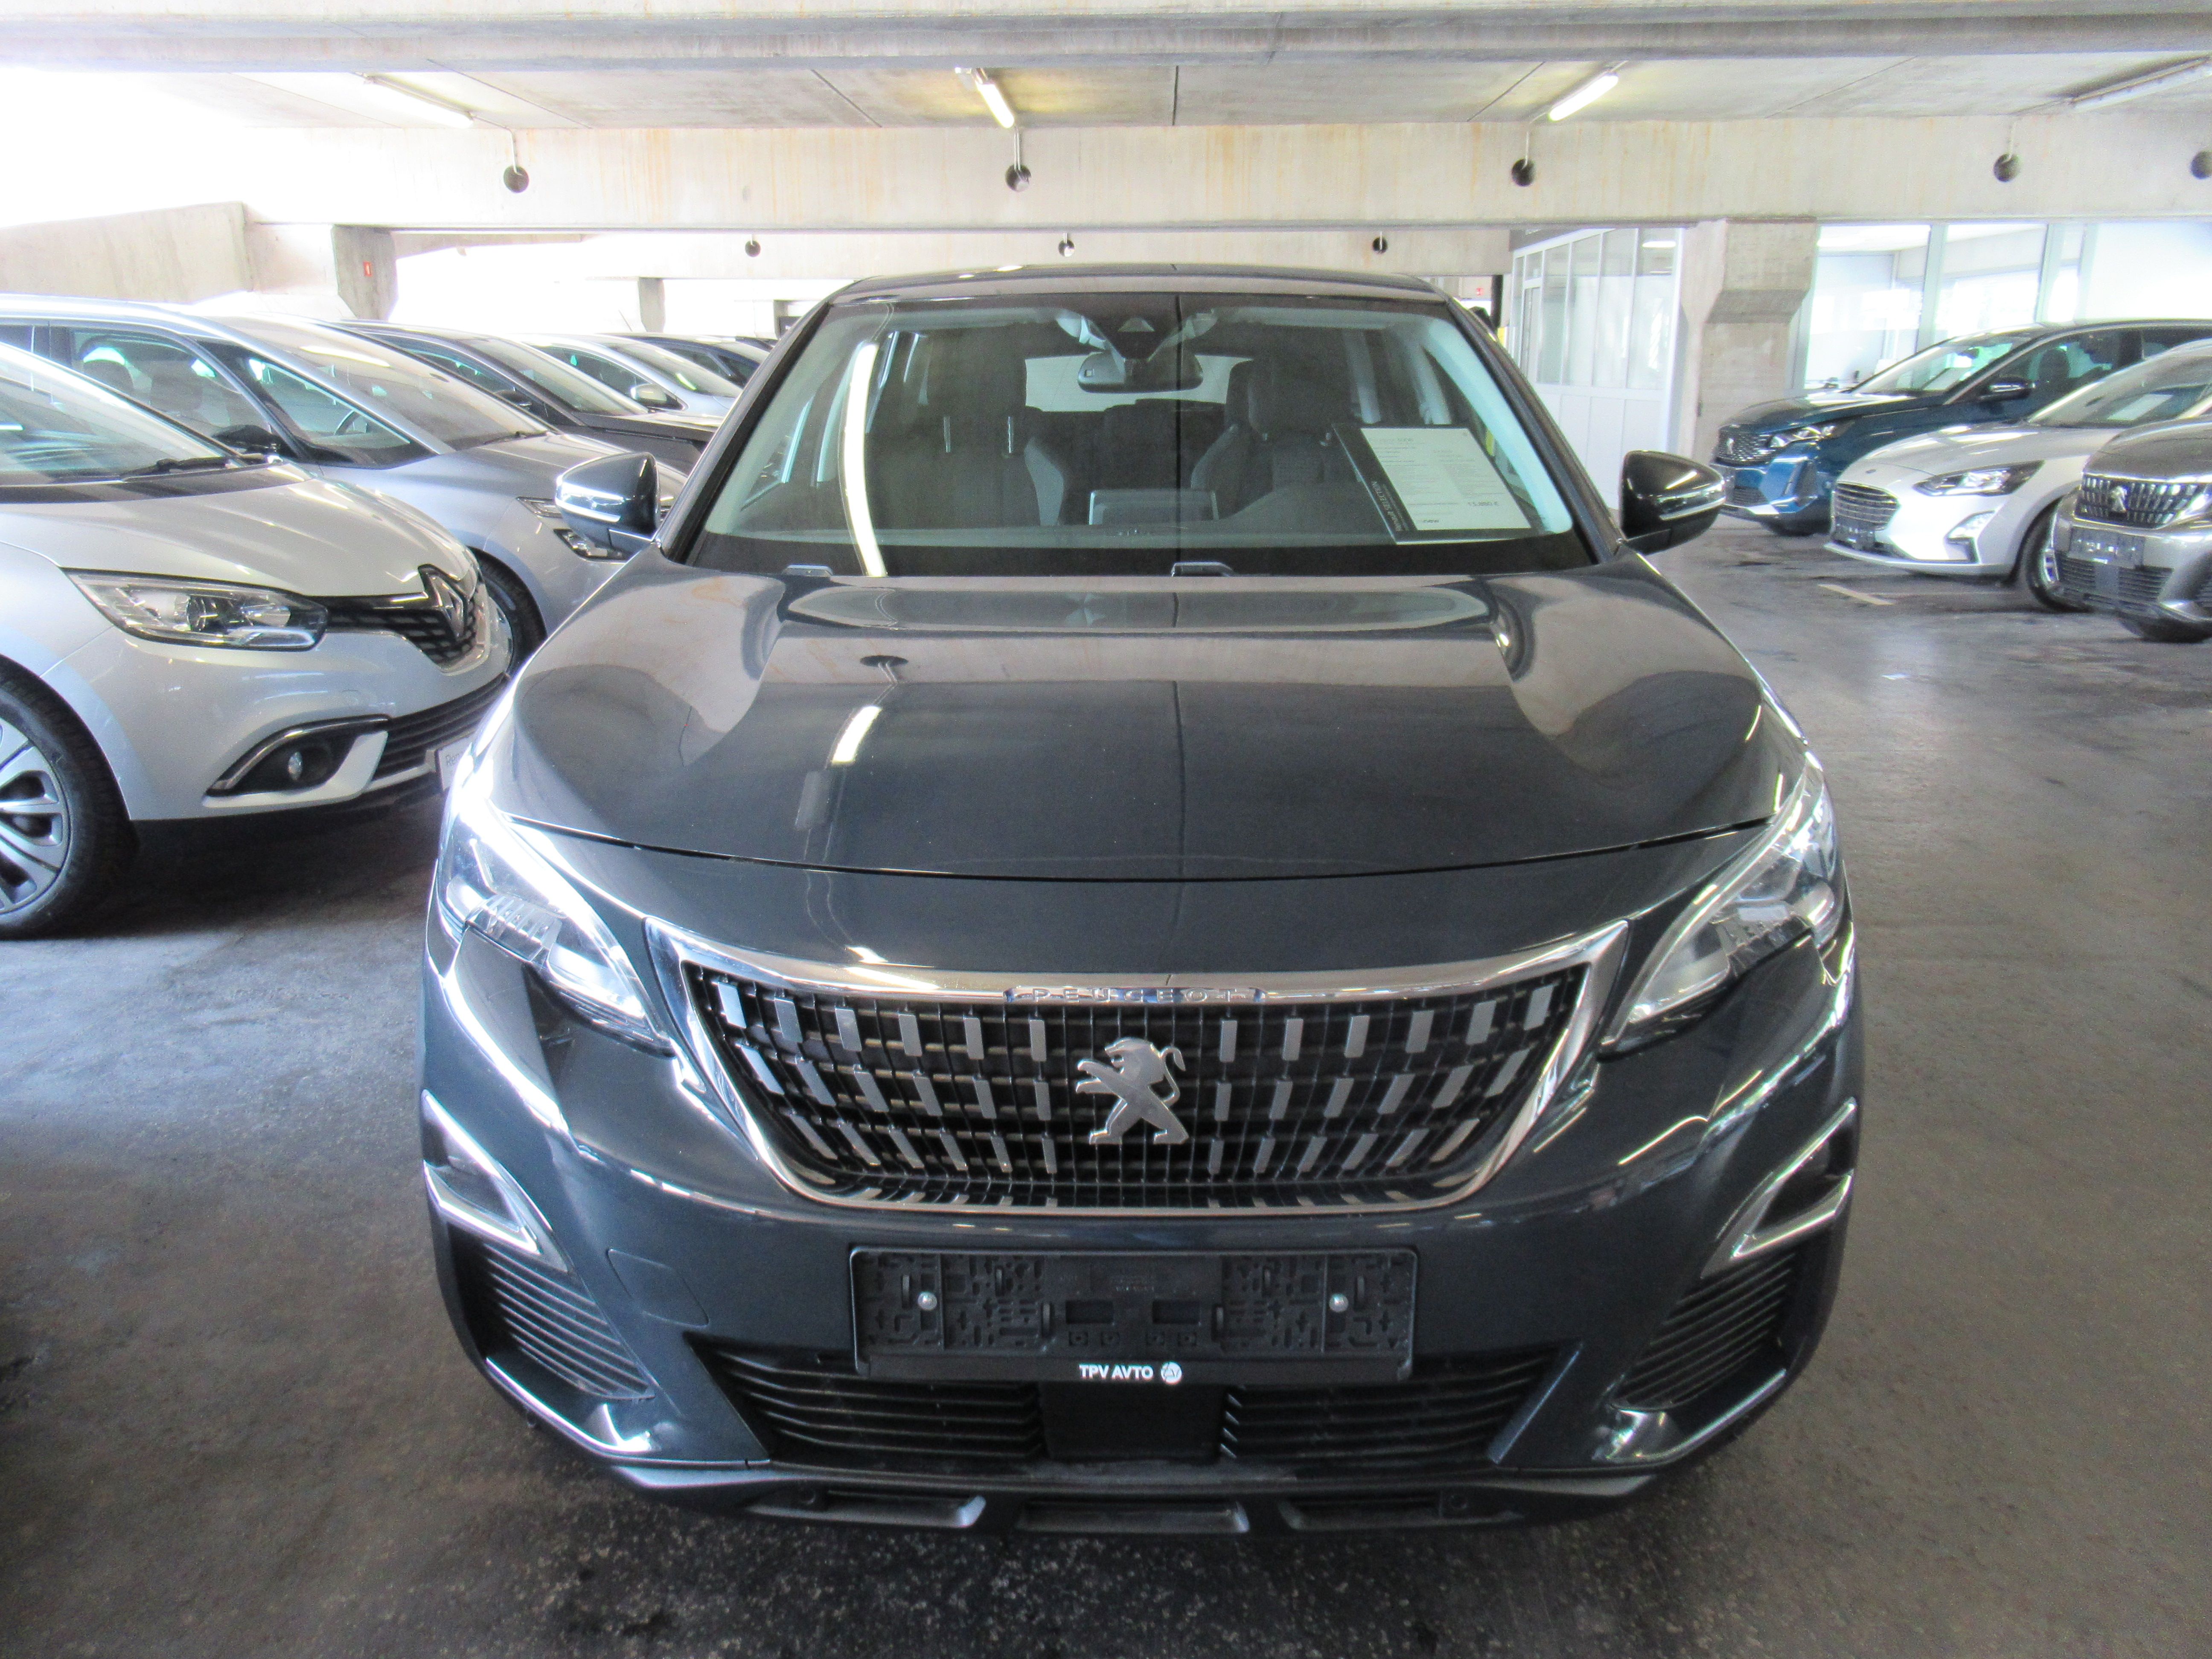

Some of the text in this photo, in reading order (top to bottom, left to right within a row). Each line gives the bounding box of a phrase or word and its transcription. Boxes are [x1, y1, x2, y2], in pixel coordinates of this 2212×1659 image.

[1033, 987, 1241, 1003] PEUGEOT
[1079, 1364, 1154, 1380] TPV AVTO
